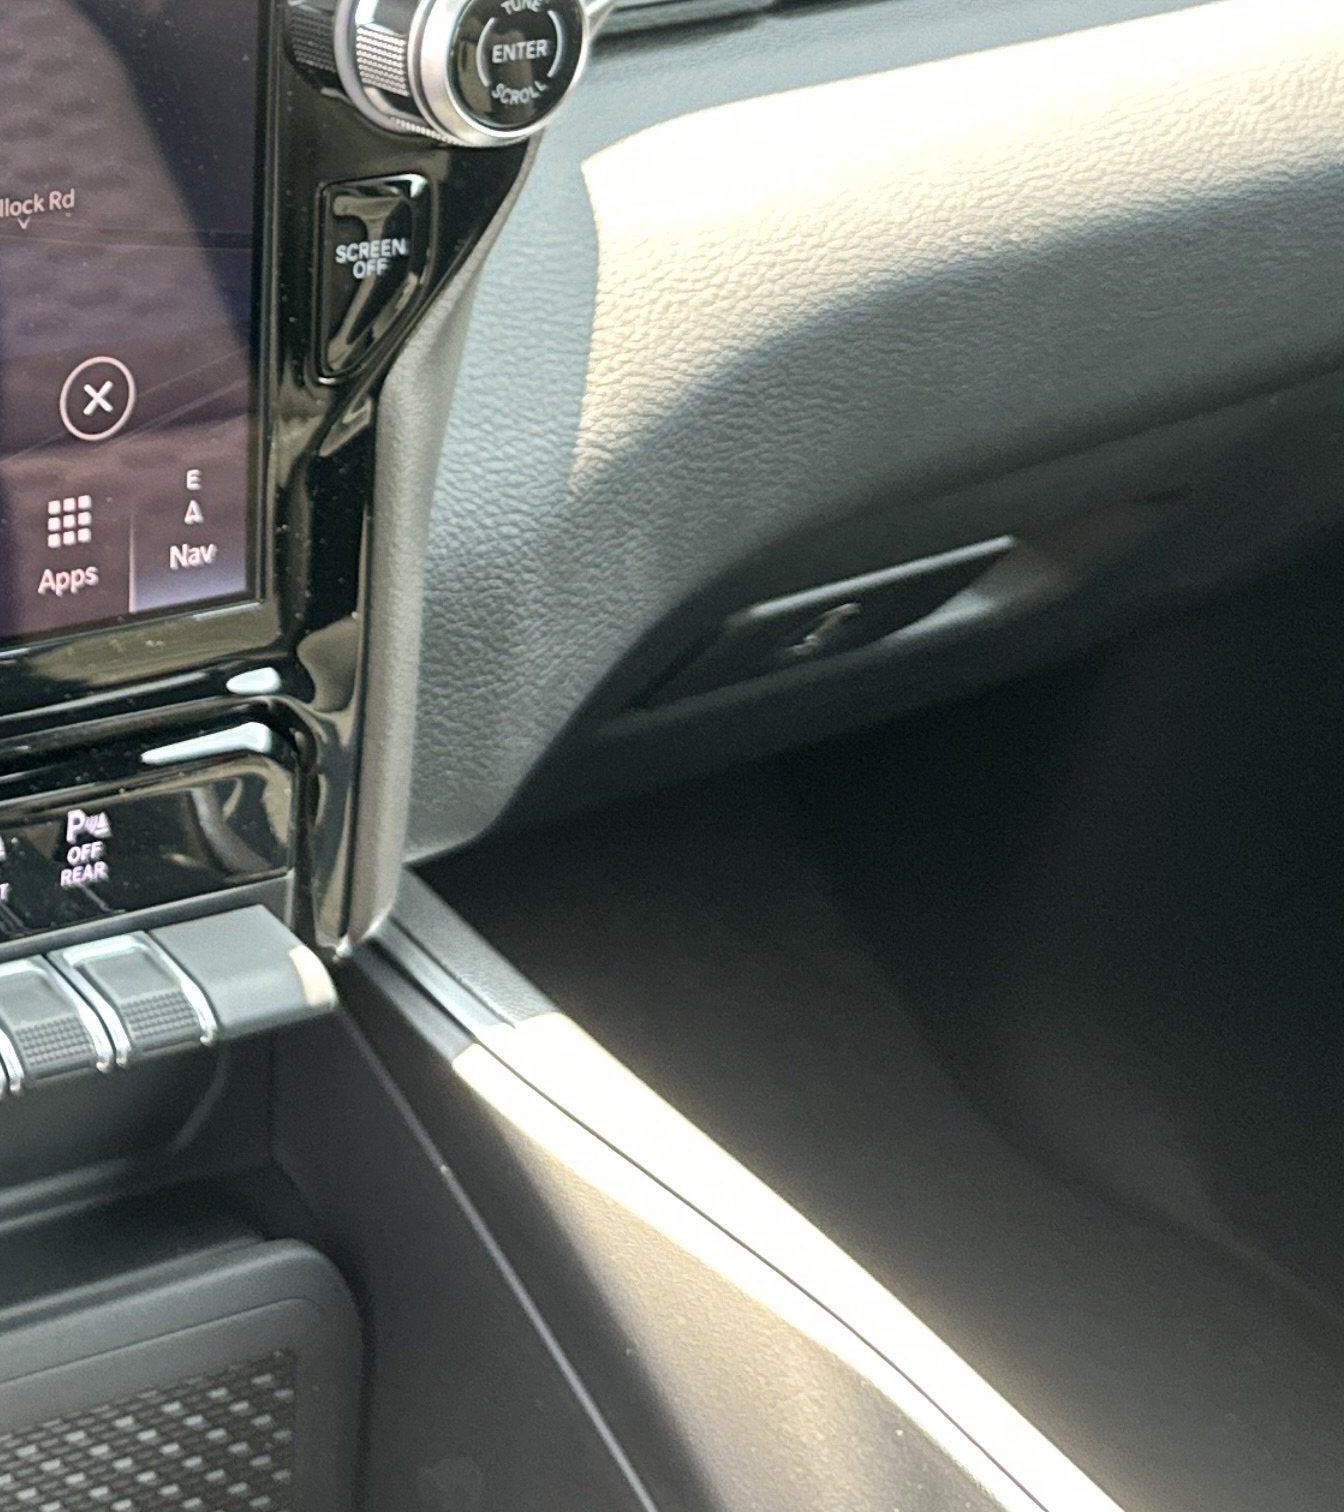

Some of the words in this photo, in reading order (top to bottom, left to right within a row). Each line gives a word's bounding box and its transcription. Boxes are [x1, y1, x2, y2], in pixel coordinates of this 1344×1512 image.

[492, 40, 548, 64] ENTER
[491, 80, 548, 105] SCROLL
[49, 188, 75, 210] Rd
[335, 238, 406, 263] SCREEN
[352, 259, 389, 279] OFF
[186, 468, 202, 490] E
[169, 543, 217, 570] Nav
[38, 565, 99, 597] Apps
[66, 841, 103, 866] OFF
[60, 860, 109, 887] REAR
